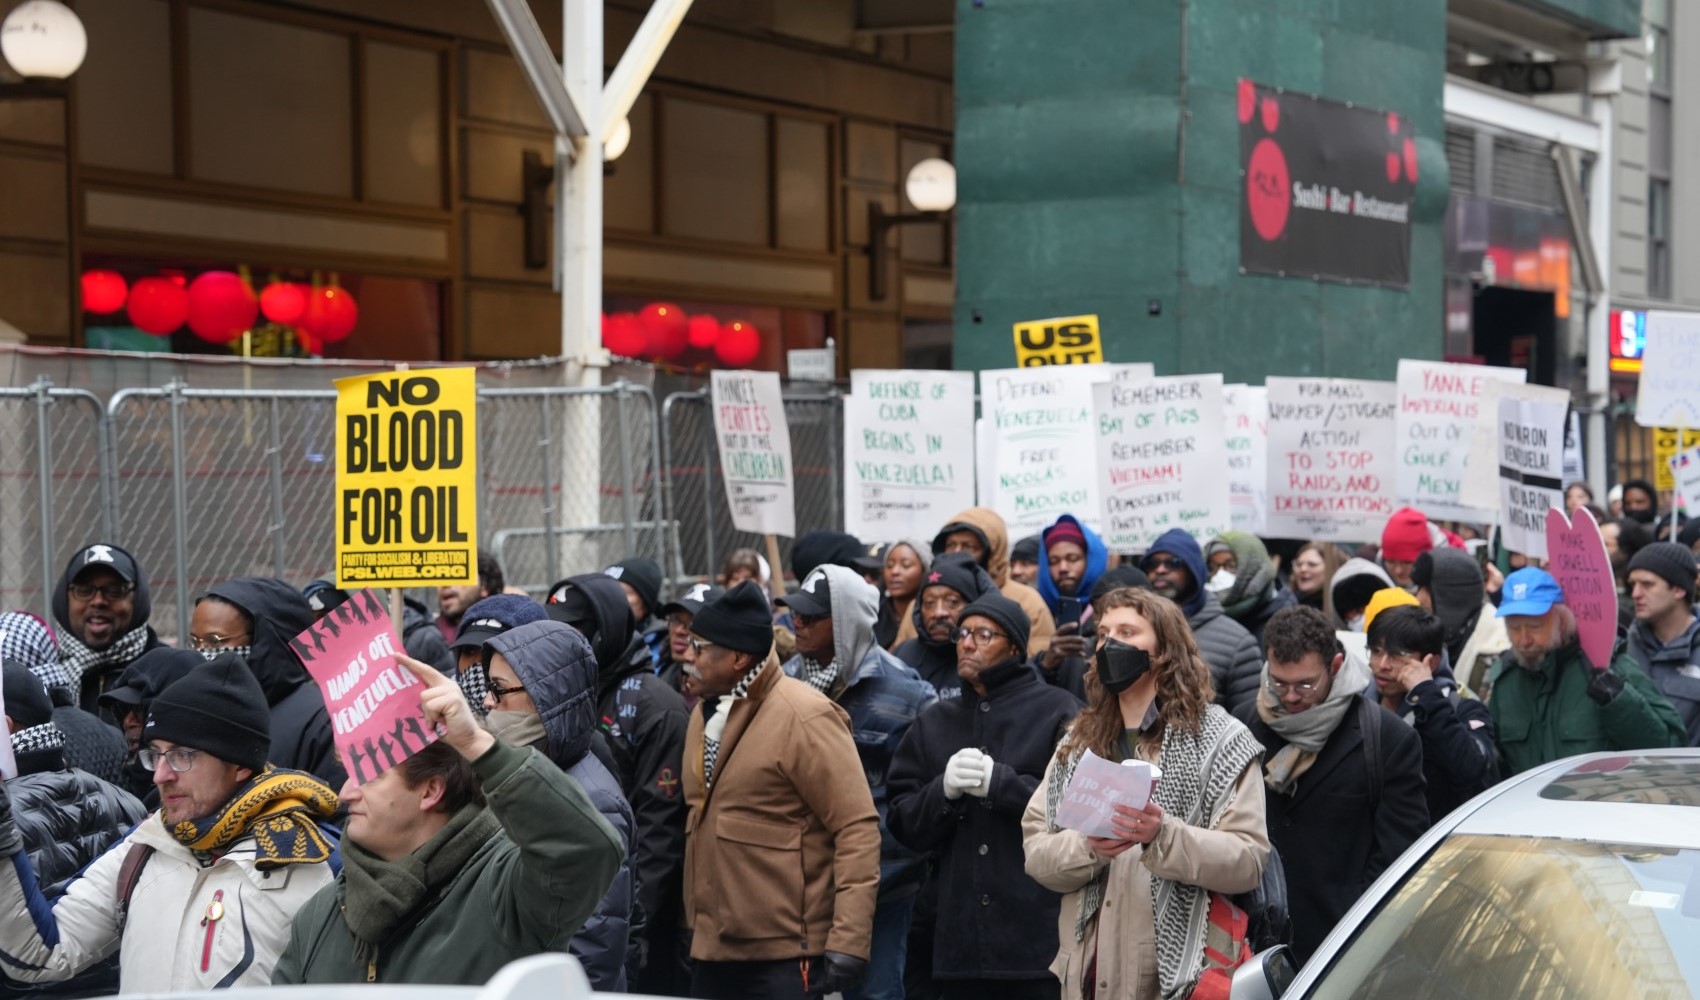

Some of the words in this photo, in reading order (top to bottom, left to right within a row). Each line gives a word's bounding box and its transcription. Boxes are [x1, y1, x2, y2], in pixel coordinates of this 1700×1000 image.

[1293, 181, 1327, 211] Sushi
[1330, 187, 1350, 214] Bar
[1353, 190, 1408, 224] Restaurant
[1020, 323, 1093, 350] US
[1023, 351, 1095, 368] OUT
[367, 377, 440, 408] NO
[868, 381, 922, 399] DEFENSE
[931, 383, 948, 399] OF
[1111, 381, 1202, 408] REMEMBER
[1299, 383, 1323, 397] FOR
[1328, 384, 1364, 399] MASS
[1423, 370, 1482, 396] YANKE
[879, 403, 919, 421] CUBA
[1268, 401, 1397, 428] WORKER/STUDENT
[1402, 393, 1479, 418] IMPERIALIS
[994, 406, 1088, 430] VENEZUELA
[1100, 413, 1124, 435] BAY
[1135, 411, 1155, 429] OF
[1165, 407, 1200, 426] PIGS
[346, 409, 463, 474] BLOOD
[863, 428, 915, 454] BEGINS
[926, 433, 942, 454] IN
[1300, 430, 1360, 449] ACTION
[1409, 422, 1439, 440] OUT
[1446, 423, 1461, 440] OF
[1020, 448, 1059, 465] FREE
[1111, 436, 1195, 461] REMEMBER
[1286, 451, 1312, 471] TO
[1326, 450, 1374, 471] STOP
[1404, 444, 1450, 467] GULF
[855, 460, 954, 485] VENEZUELA!
[1109, 462, 1183, 485] VIETNAM!
[1289, 472, 1342, 492] RAIDS
[1344, 474, 1380, 493] AND
[1417, 473, 1461, 495] MEXI
[1106, 490, 1182, 514] DEMOCRATIC
[1275, 495, 1394, 515] DEPORTATIONS
[343, 487, 402, 545] FOR
[411, 485, 468, 544] OIL
[1111, 515, 1144, 532] PARTY
[343, 554, 363, 566] PARTY
[364, 553, 377, 566] FOR
[377, 552, 412, 566] SOCIALISM
[412, 552, 422, 565] &
[423, 551, 467, 565] LIBERATION
[343, 565, 467, 579] PSLWEB.ORG
[326, 651, 368, 701] HANDS
[368, 632, 395, 661] OFF
[333, 663, 419, 735] VENEZUELA
